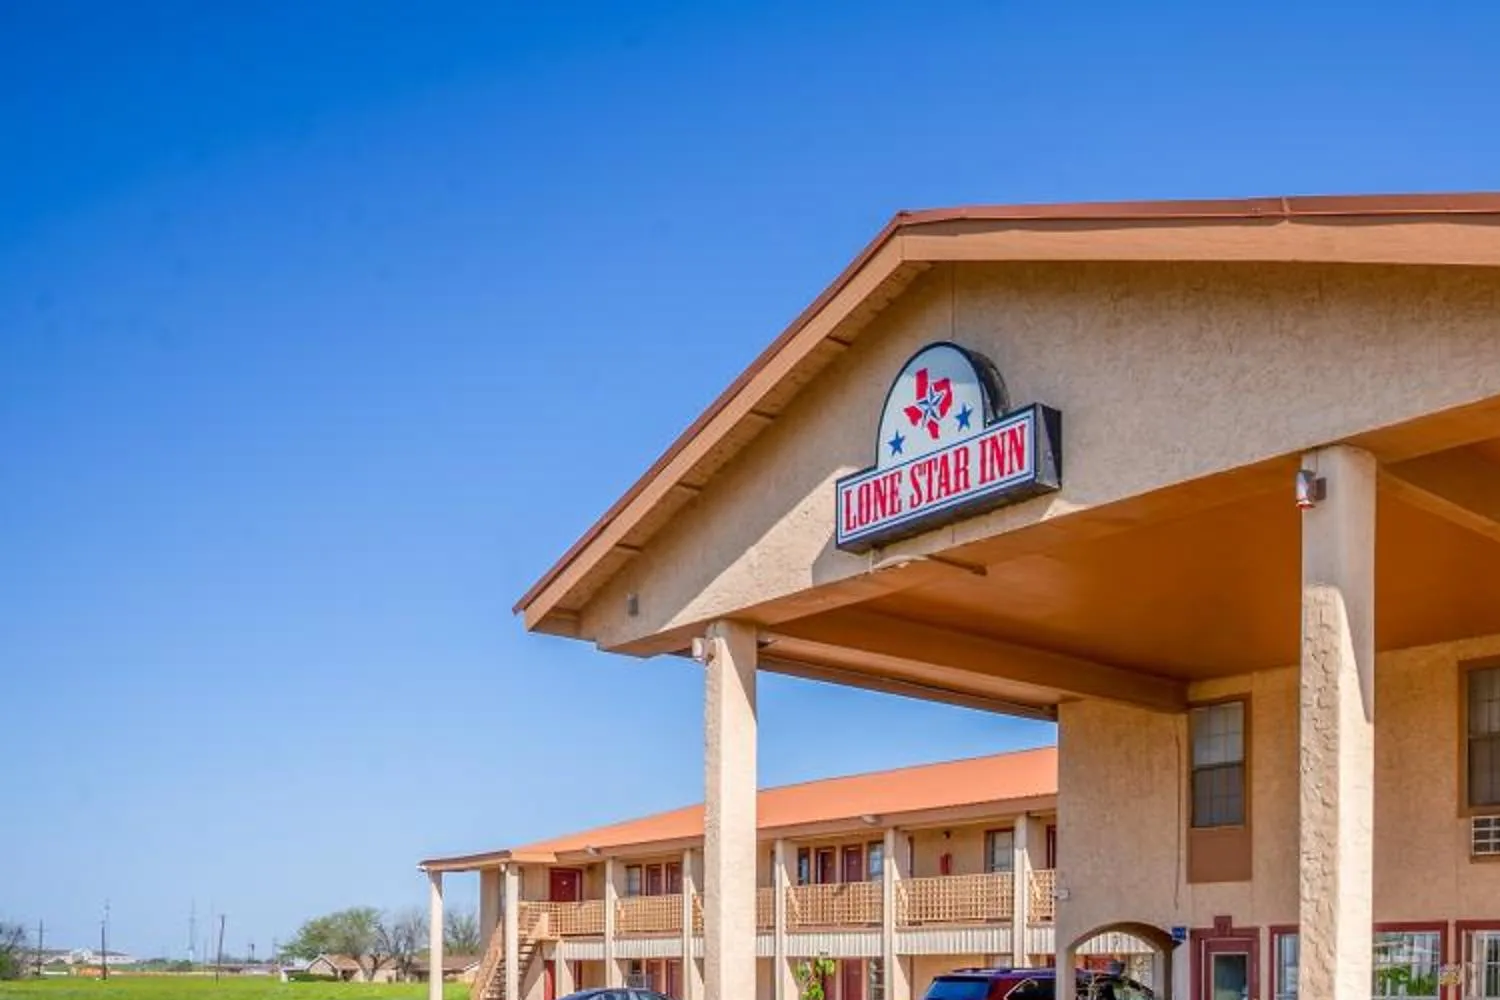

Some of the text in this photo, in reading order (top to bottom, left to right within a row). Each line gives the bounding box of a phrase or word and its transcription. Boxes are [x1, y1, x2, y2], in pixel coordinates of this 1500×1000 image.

[844, 424, 1026, 531] LONE STAR INN
